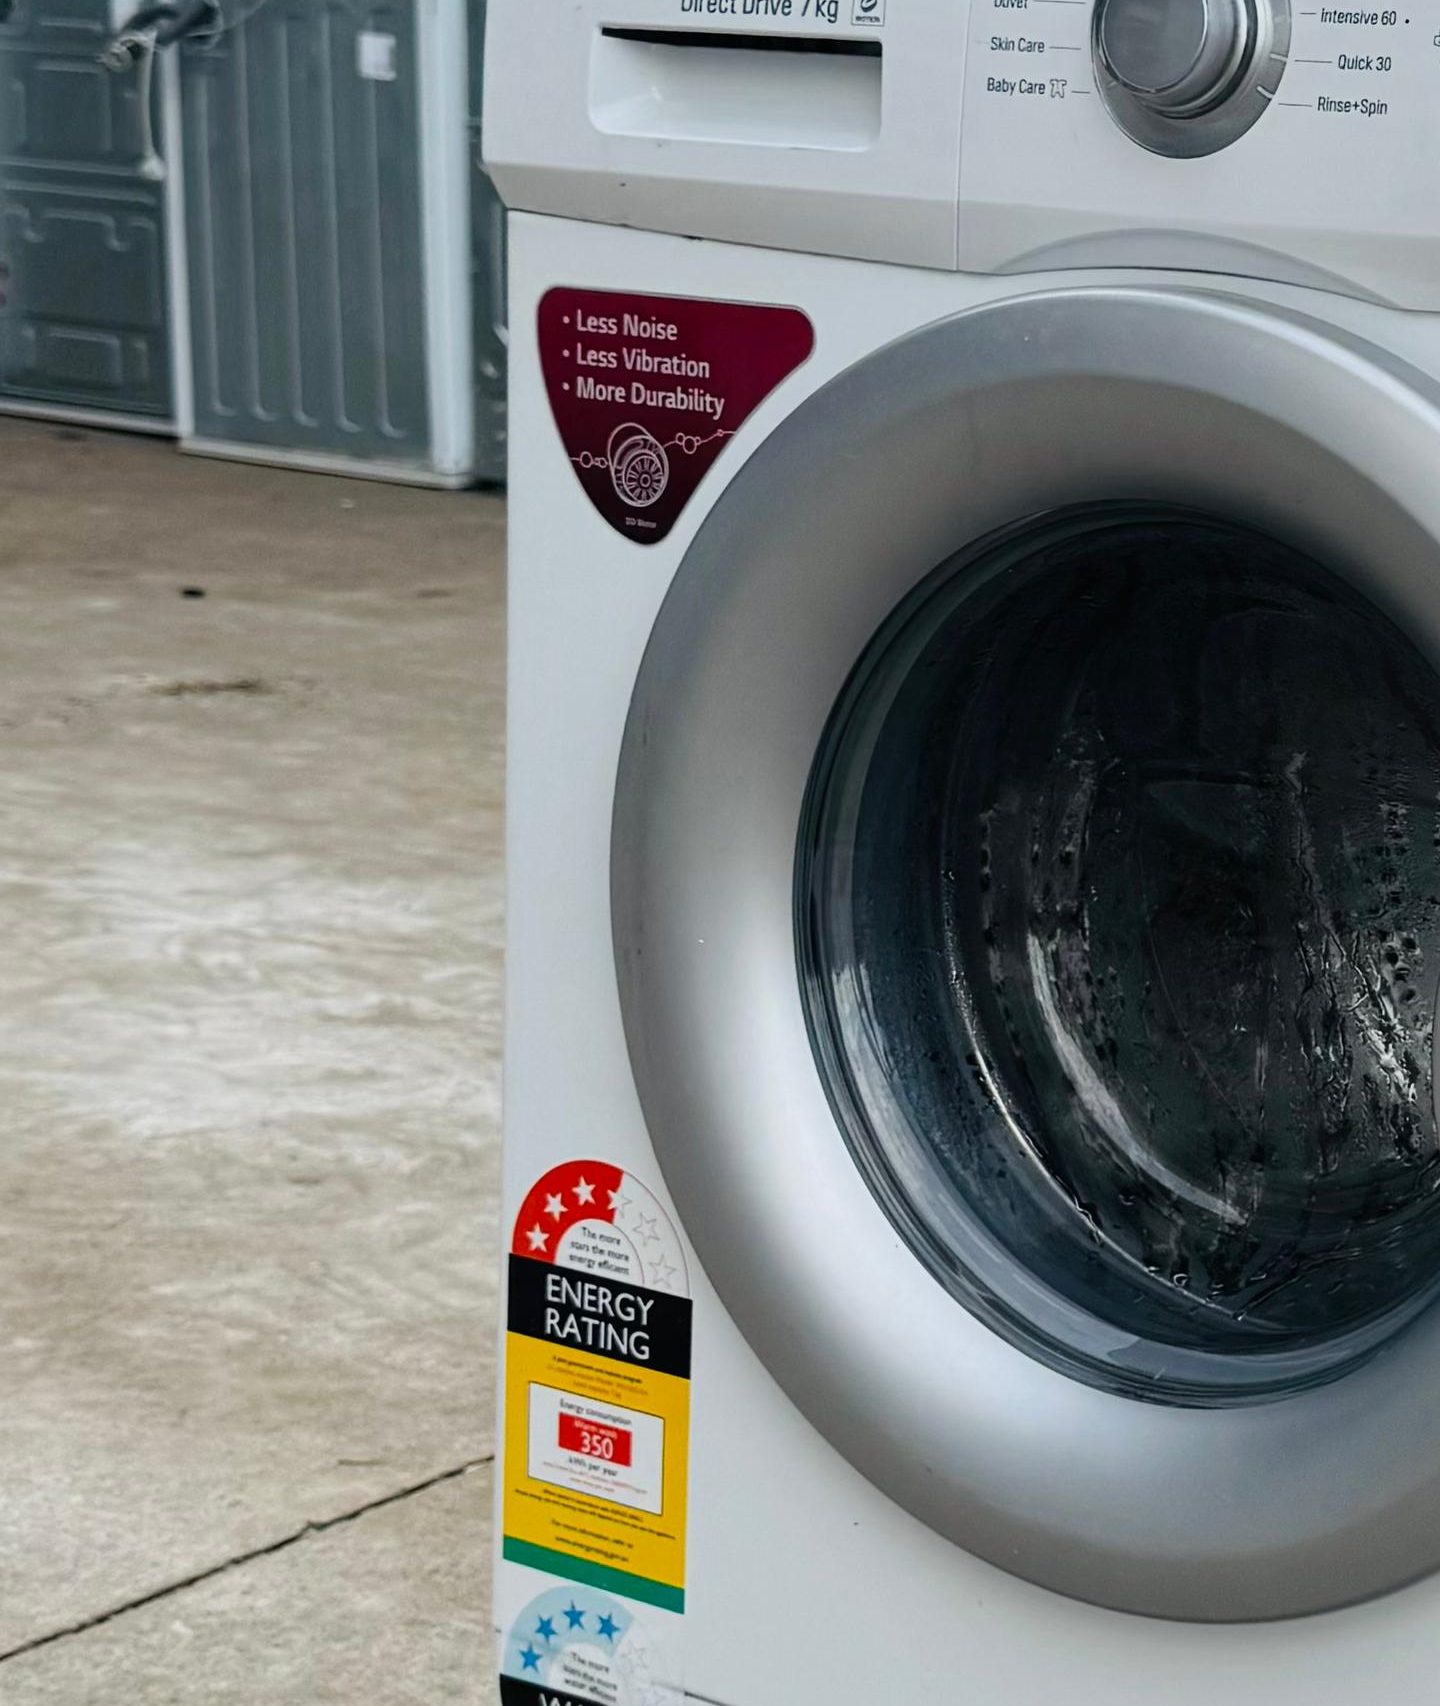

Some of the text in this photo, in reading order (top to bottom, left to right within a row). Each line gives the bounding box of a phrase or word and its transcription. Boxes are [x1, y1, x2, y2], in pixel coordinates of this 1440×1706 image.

[1381, 10, 1397, 26] 60
[990, 36, 1045, 53] Skin Care
[1338, 54, 1392, 72] Quick 30
[987, 77, 1046, 96] Baby Care
[1317, 96, 1388, 118] Rinse+Spin
[576, 309, 678, 341] Less Noise
[576, 342, 711, 379] Less Vibration
[576, 375, 725, 421] More Durability
[545, 1272, 655, 1326] ENERGY
[545, 1307, 650, 1361] RATING
[580, 1431, 614, 1460] 350
